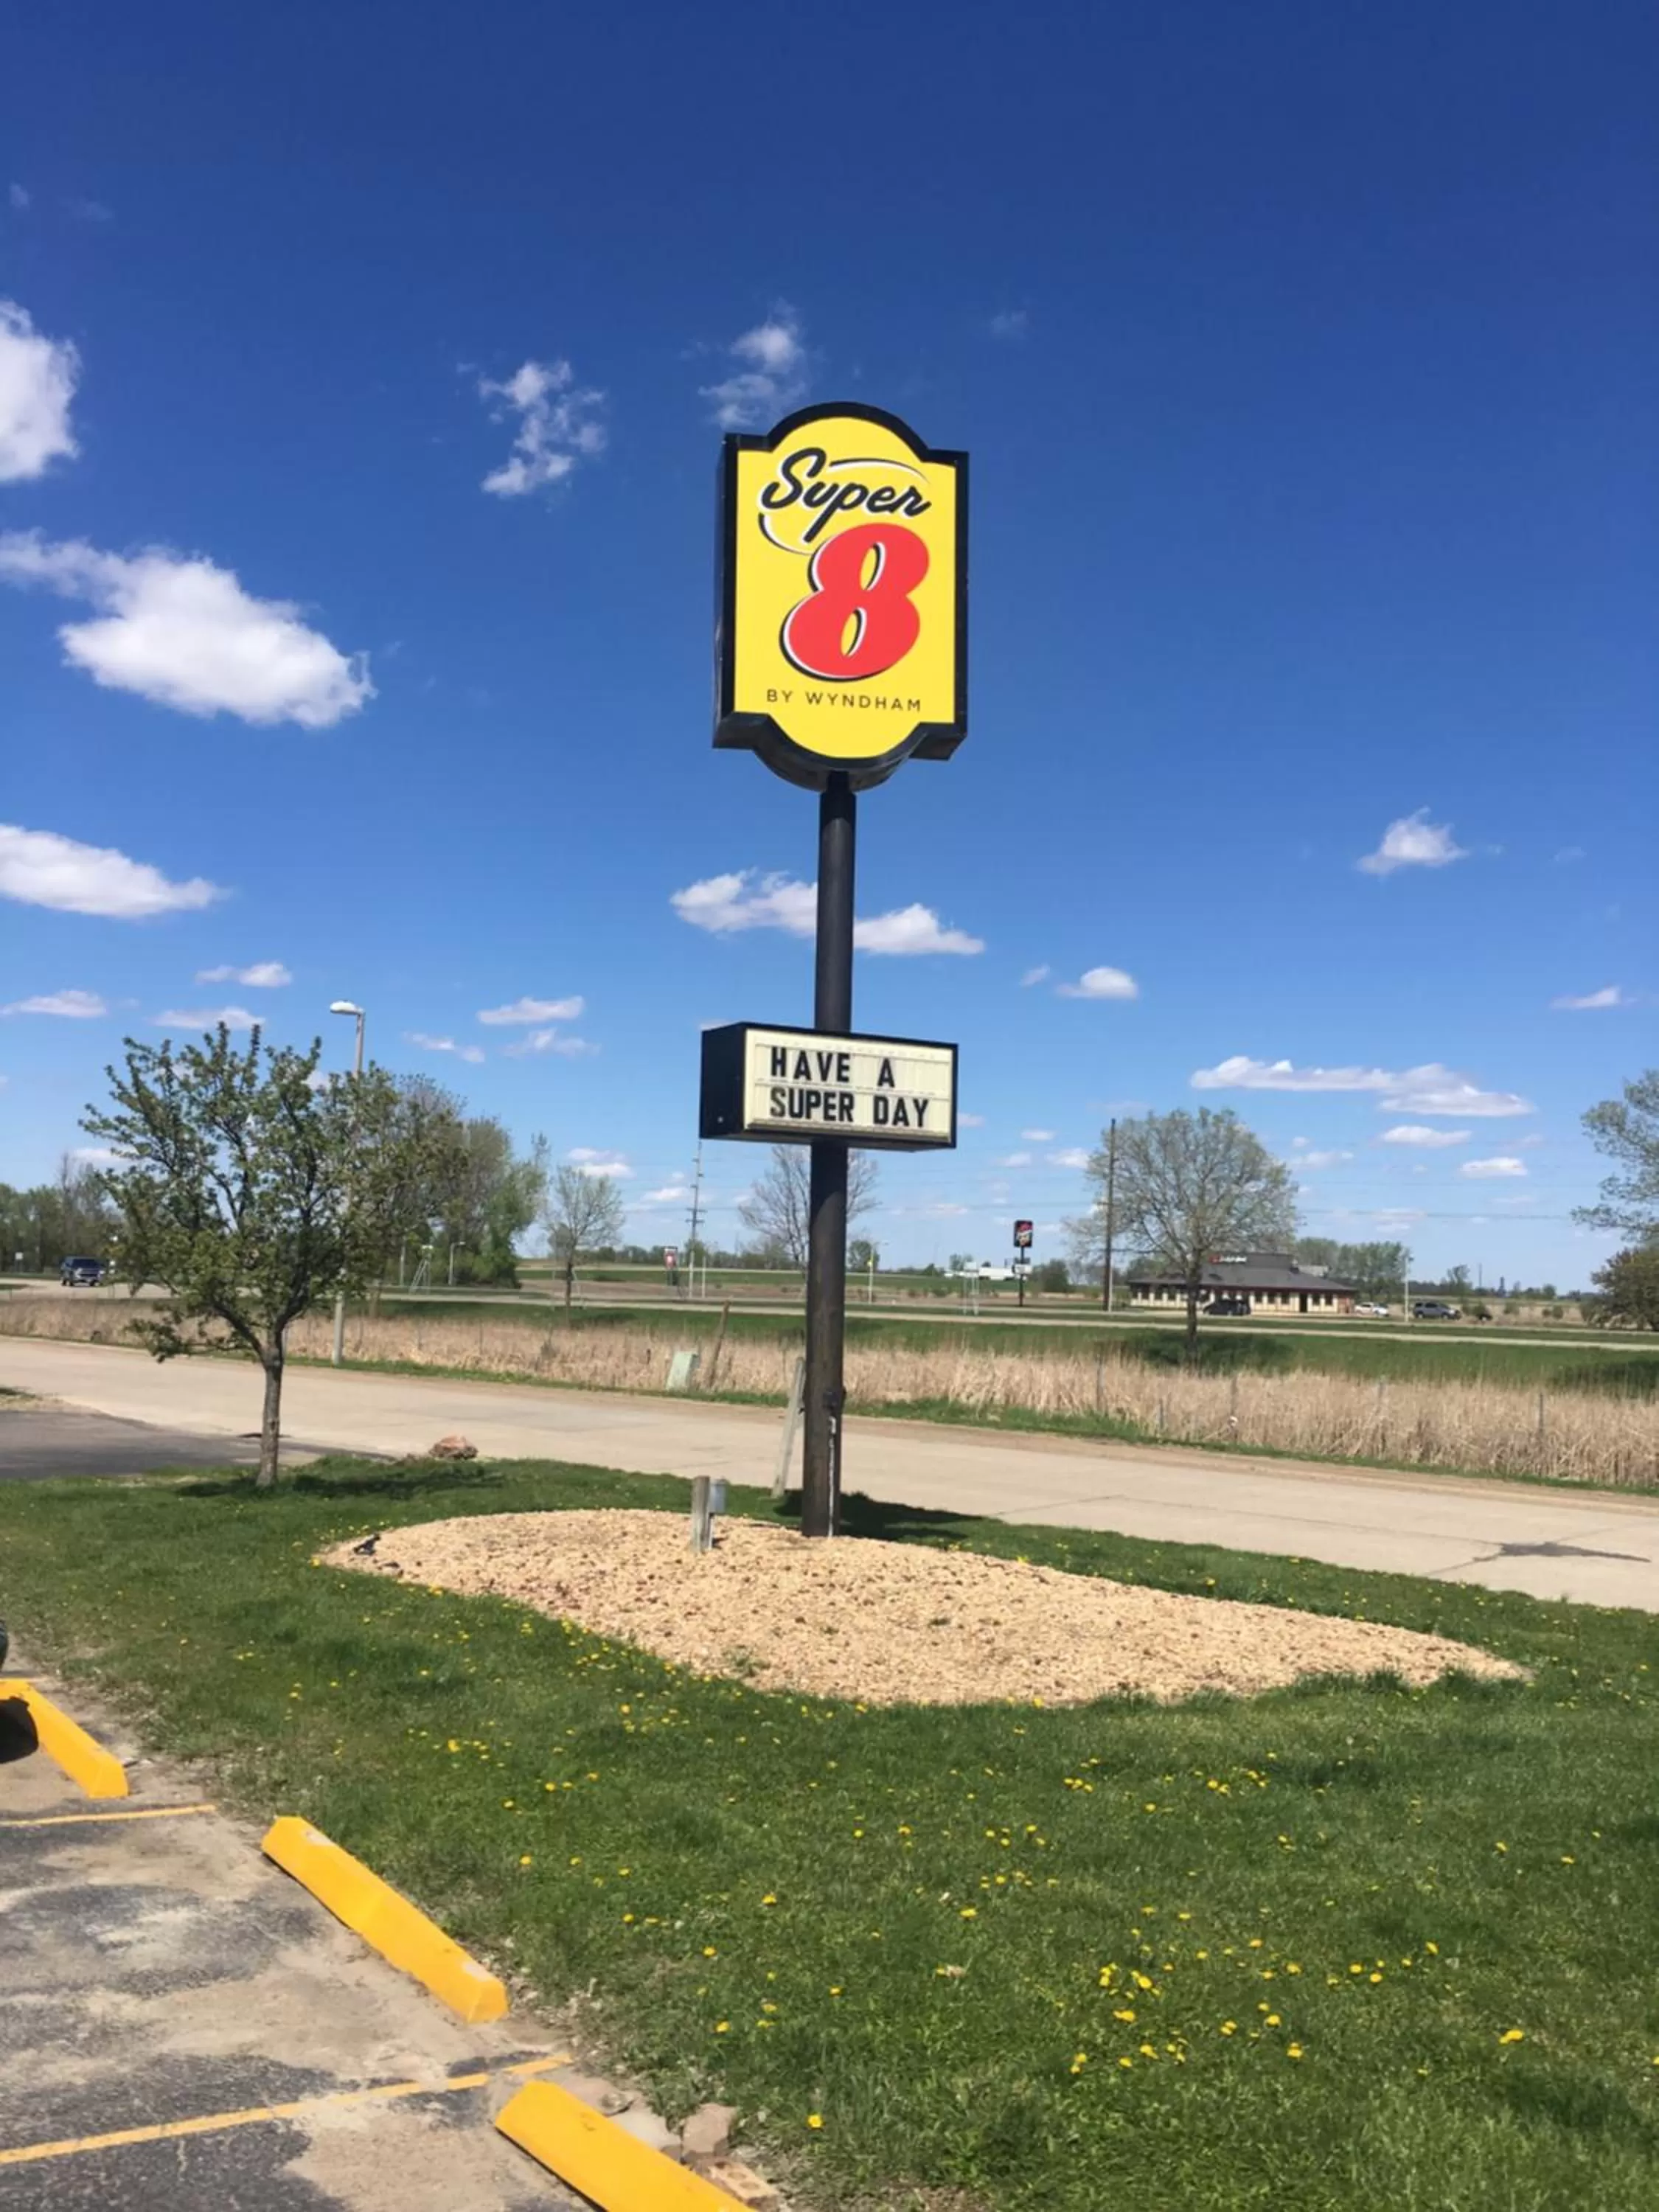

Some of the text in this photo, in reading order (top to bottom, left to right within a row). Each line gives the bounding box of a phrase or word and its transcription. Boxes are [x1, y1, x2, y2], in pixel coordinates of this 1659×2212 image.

[761, 447, 931, 543] Super
[779, 522, 930, 682] 8
[766, 689, 922, 712] BY WYNDHAM
[771, 1046, 895, 1088] HAVE A
[770, 1087, 929, 1128] SUPER DAY
